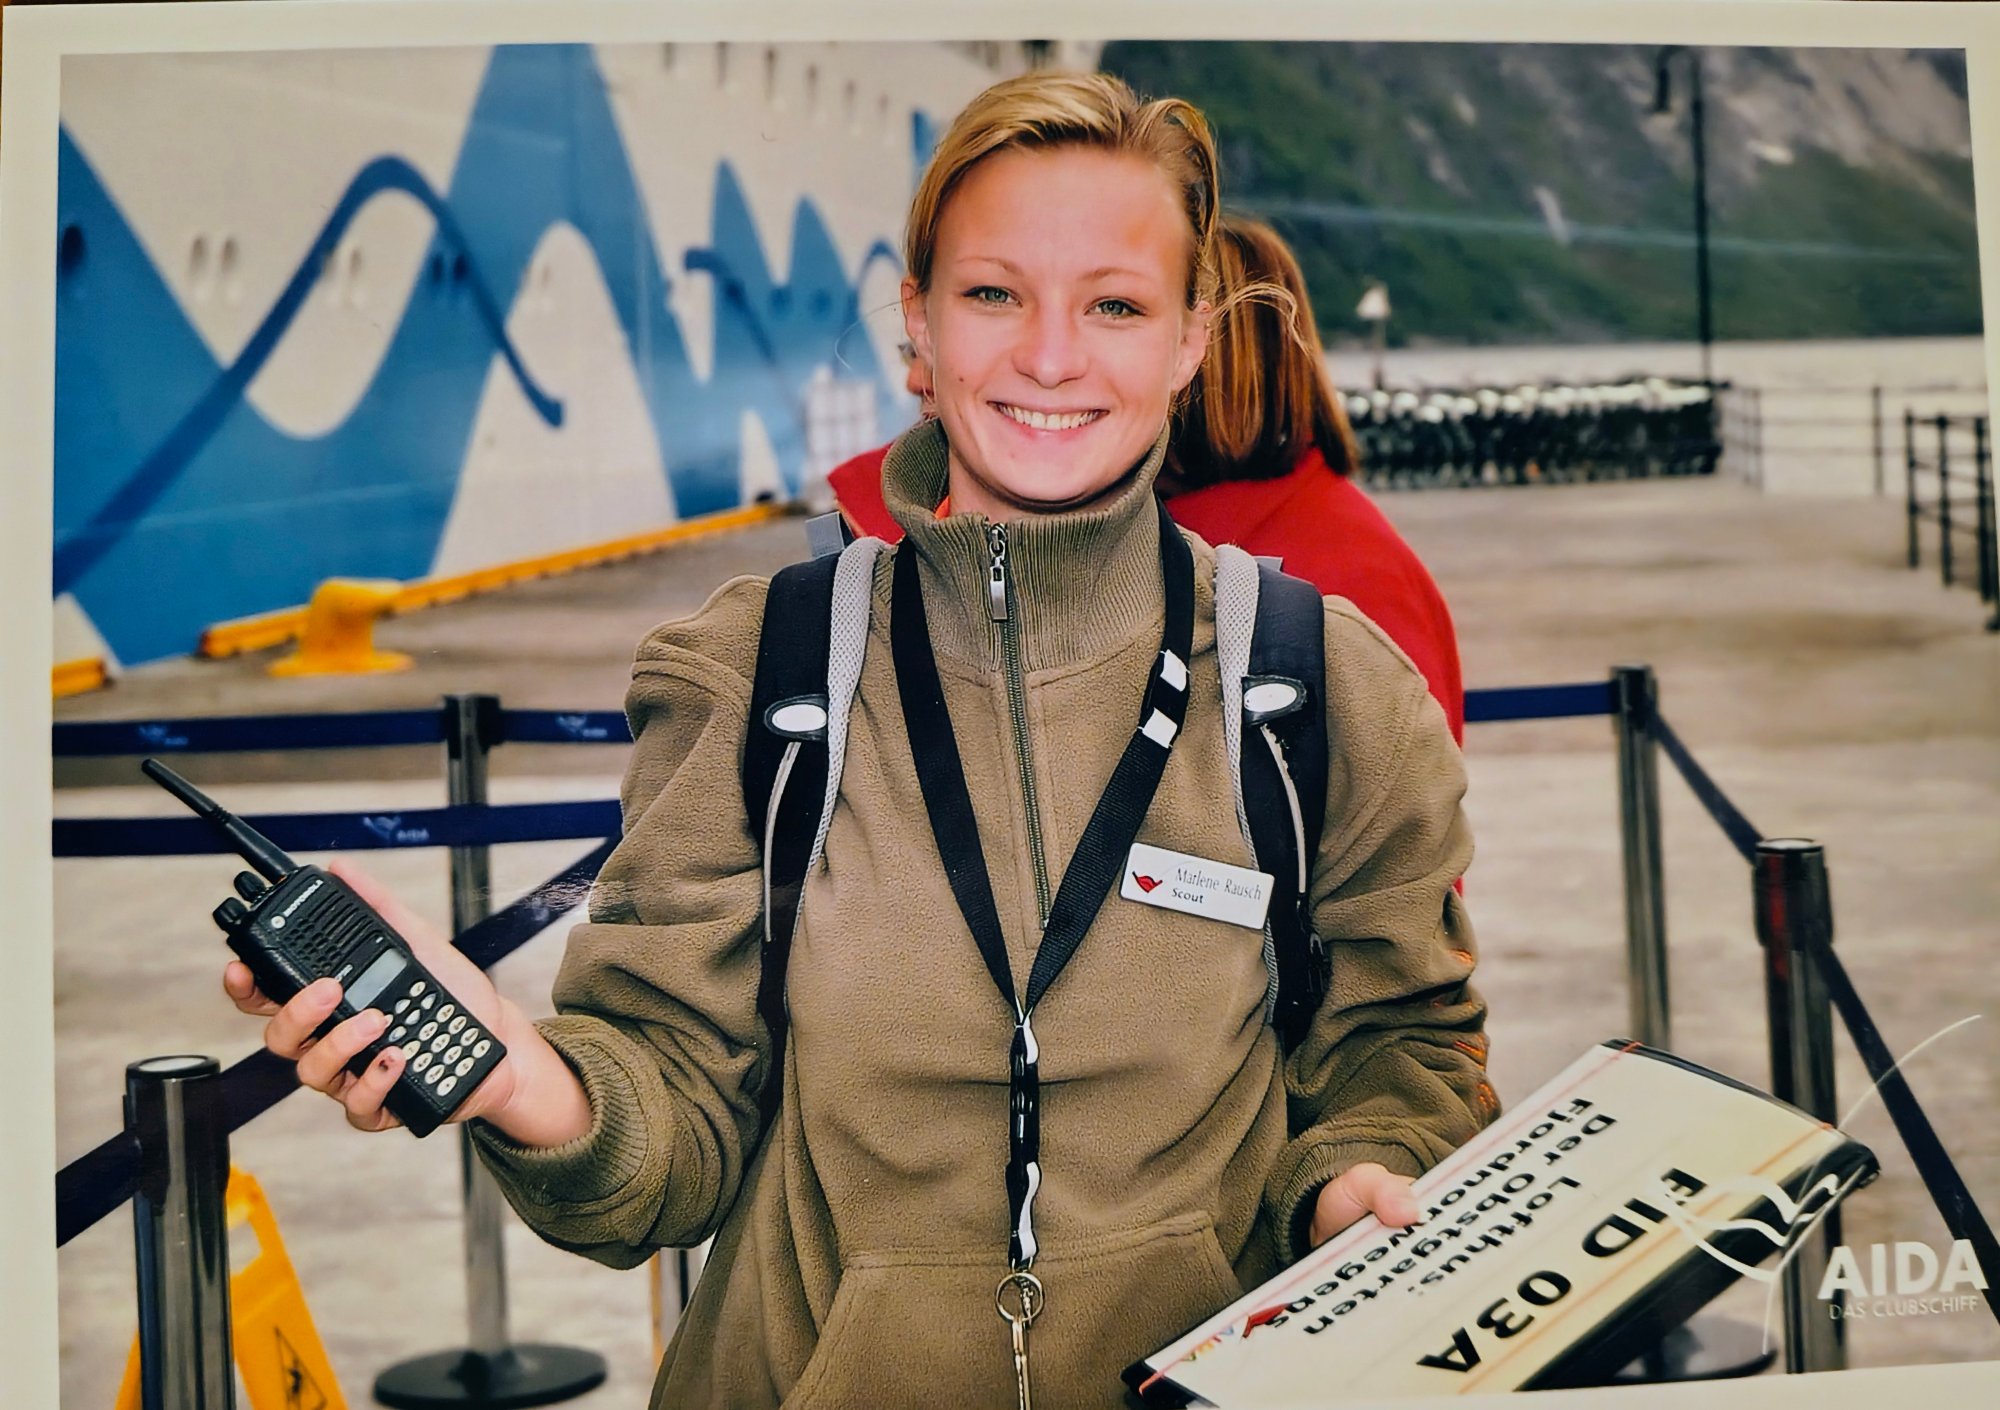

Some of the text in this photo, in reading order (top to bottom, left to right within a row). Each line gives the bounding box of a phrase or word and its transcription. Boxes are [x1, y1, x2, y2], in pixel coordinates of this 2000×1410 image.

[283, 879, 324, 917] MOTOROLA
[1172, 887, 1204, 904] Scout
[1175, 868, 1262, 901] Marlene Rausch
[1264, 1098, 1593, 1329] Fjordnorwegens
[1303, 1113, 1617, 1334] Der Obstgarten
[1407, 1176, 1582, 1297] Lofthus:
[1416, 1270, 1572, 1373] 03A
